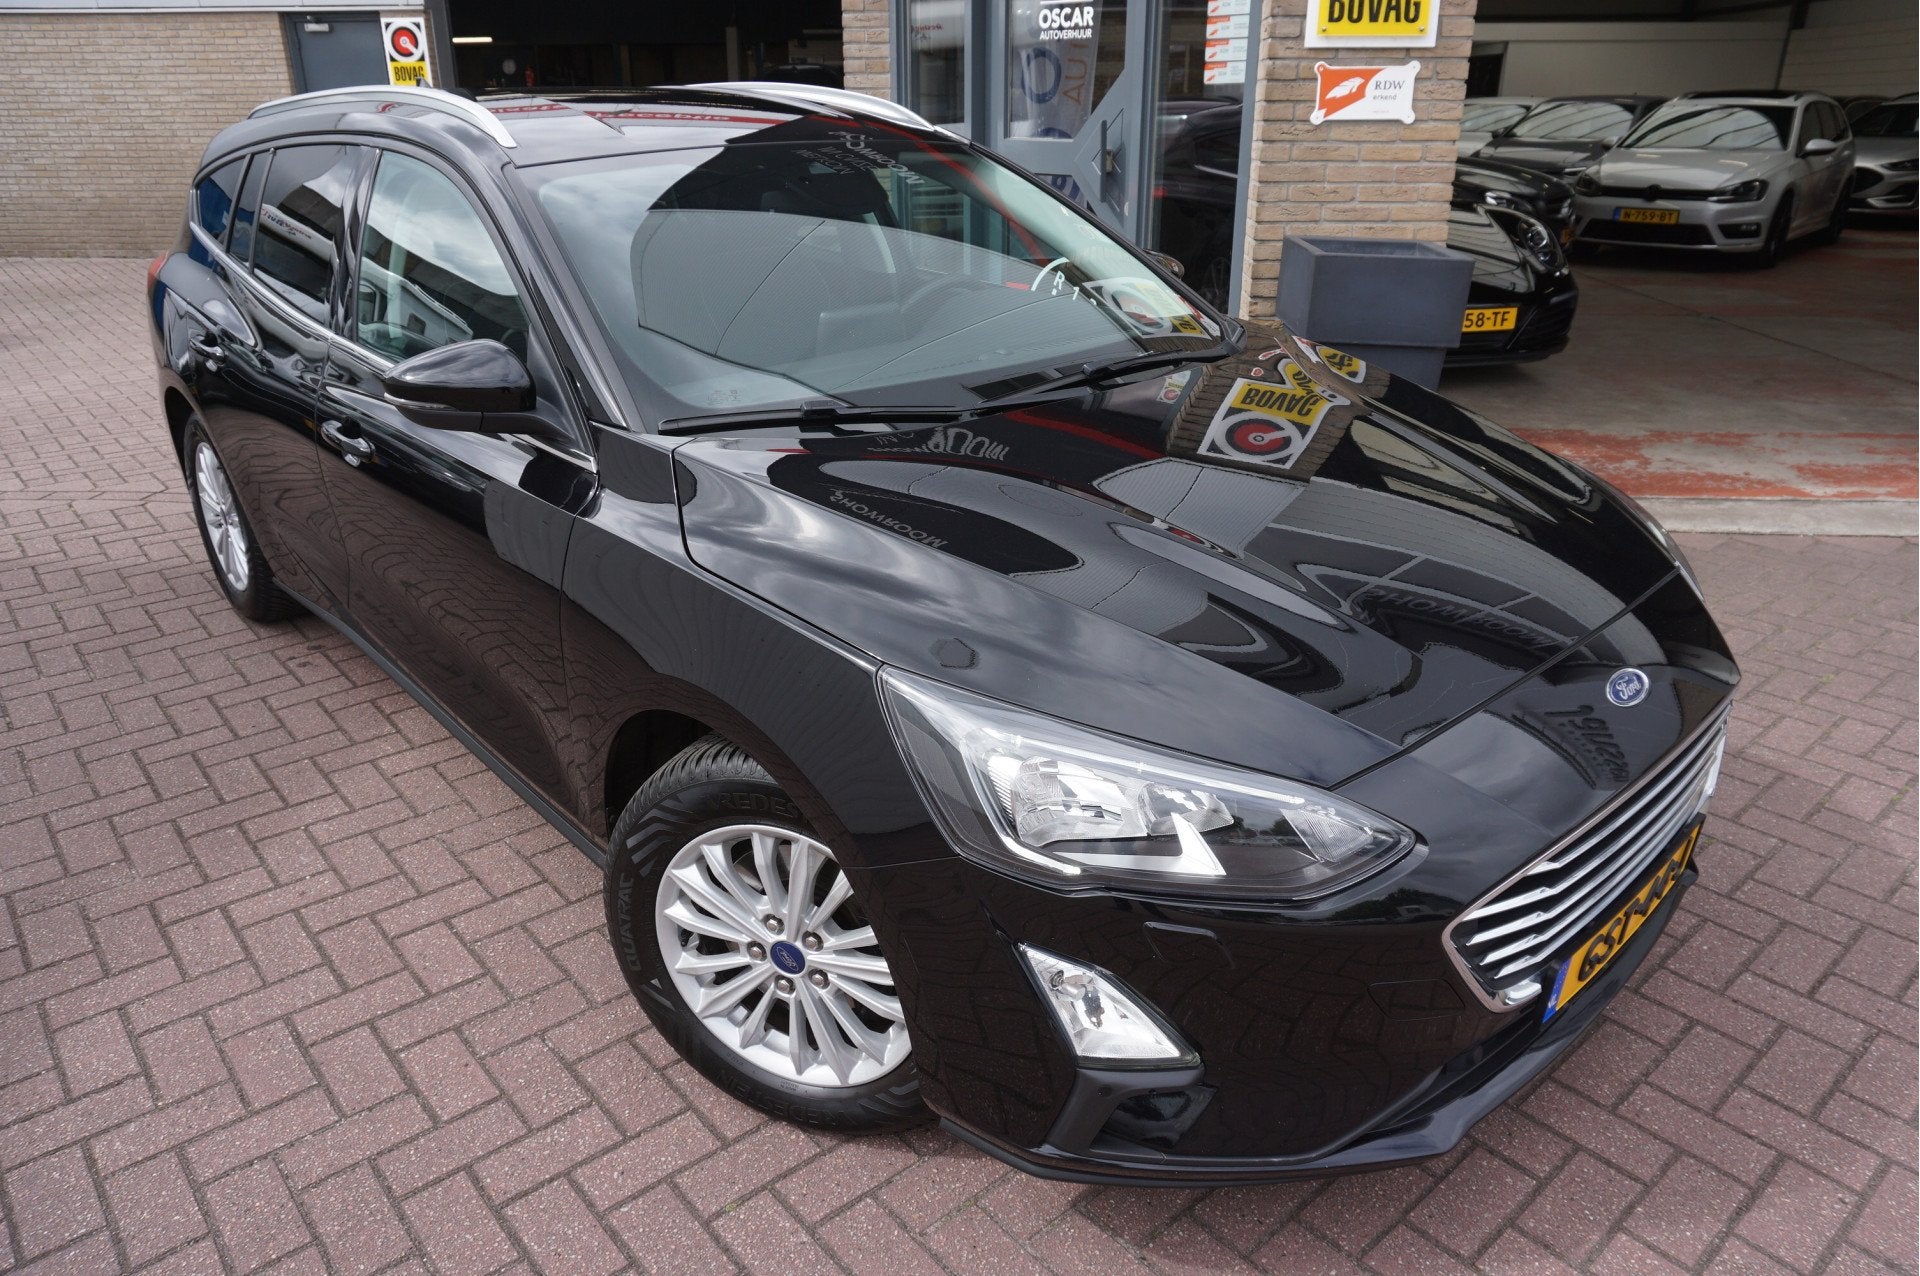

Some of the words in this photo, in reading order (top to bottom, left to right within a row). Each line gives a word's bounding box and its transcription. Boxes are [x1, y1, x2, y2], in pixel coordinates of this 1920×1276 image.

[1038, 6, 1094, 29] OSCAR
[1328, 0, 1421, 23] BOVAG
[1039, 29, 1093, 40] AUTOVERHUUR
[394, 66, 425, 82] BOVAG
[1374, 80, 1405, 91] RDW
[1623, 210, 1675, 222] N-759-BT
[1463, 311, 1511, 328] 58-TF
[1614, 674, 1643, 702] Ford
